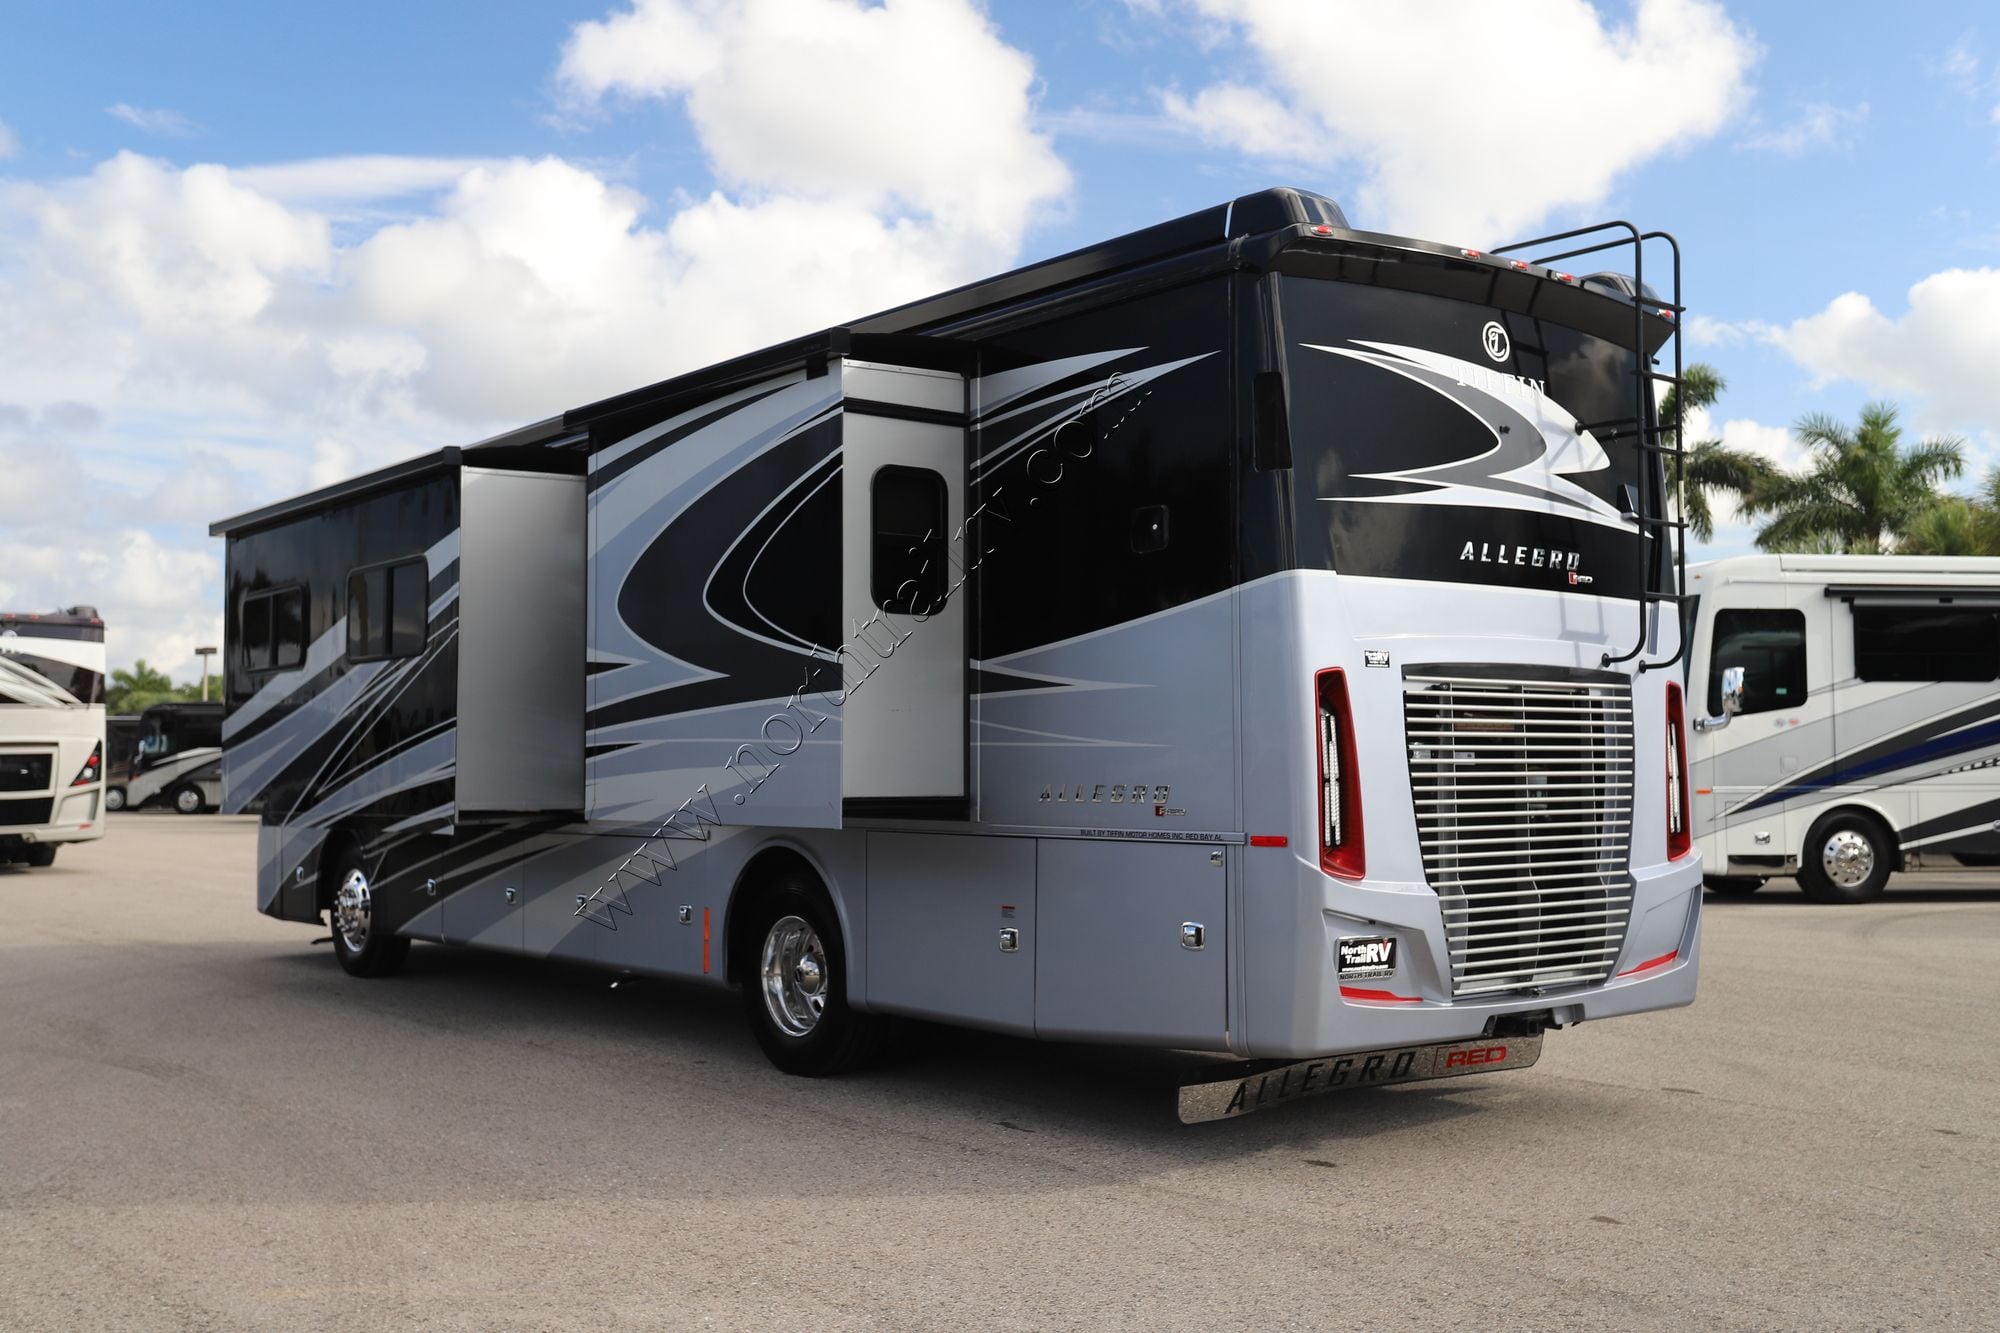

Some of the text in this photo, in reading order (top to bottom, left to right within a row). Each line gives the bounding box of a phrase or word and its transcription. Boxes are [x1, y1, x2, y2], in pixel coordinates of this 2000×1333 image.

[1455, 365, 1545, 400] TIFFIN
[1459, 541, 1580, 571] ALLEGRO
[1039, 784, 1170, 804] ALLEGRO
[1106, 830, 1124, 838] TIFFIN
[1125, 831, 1147, 839] MOTOR
[1341, 943, 1392, 963] North RV
[1345, 954, 1367, 964] Trail
[1225, 1046, 1507, 1114] ALLEGRO RED
